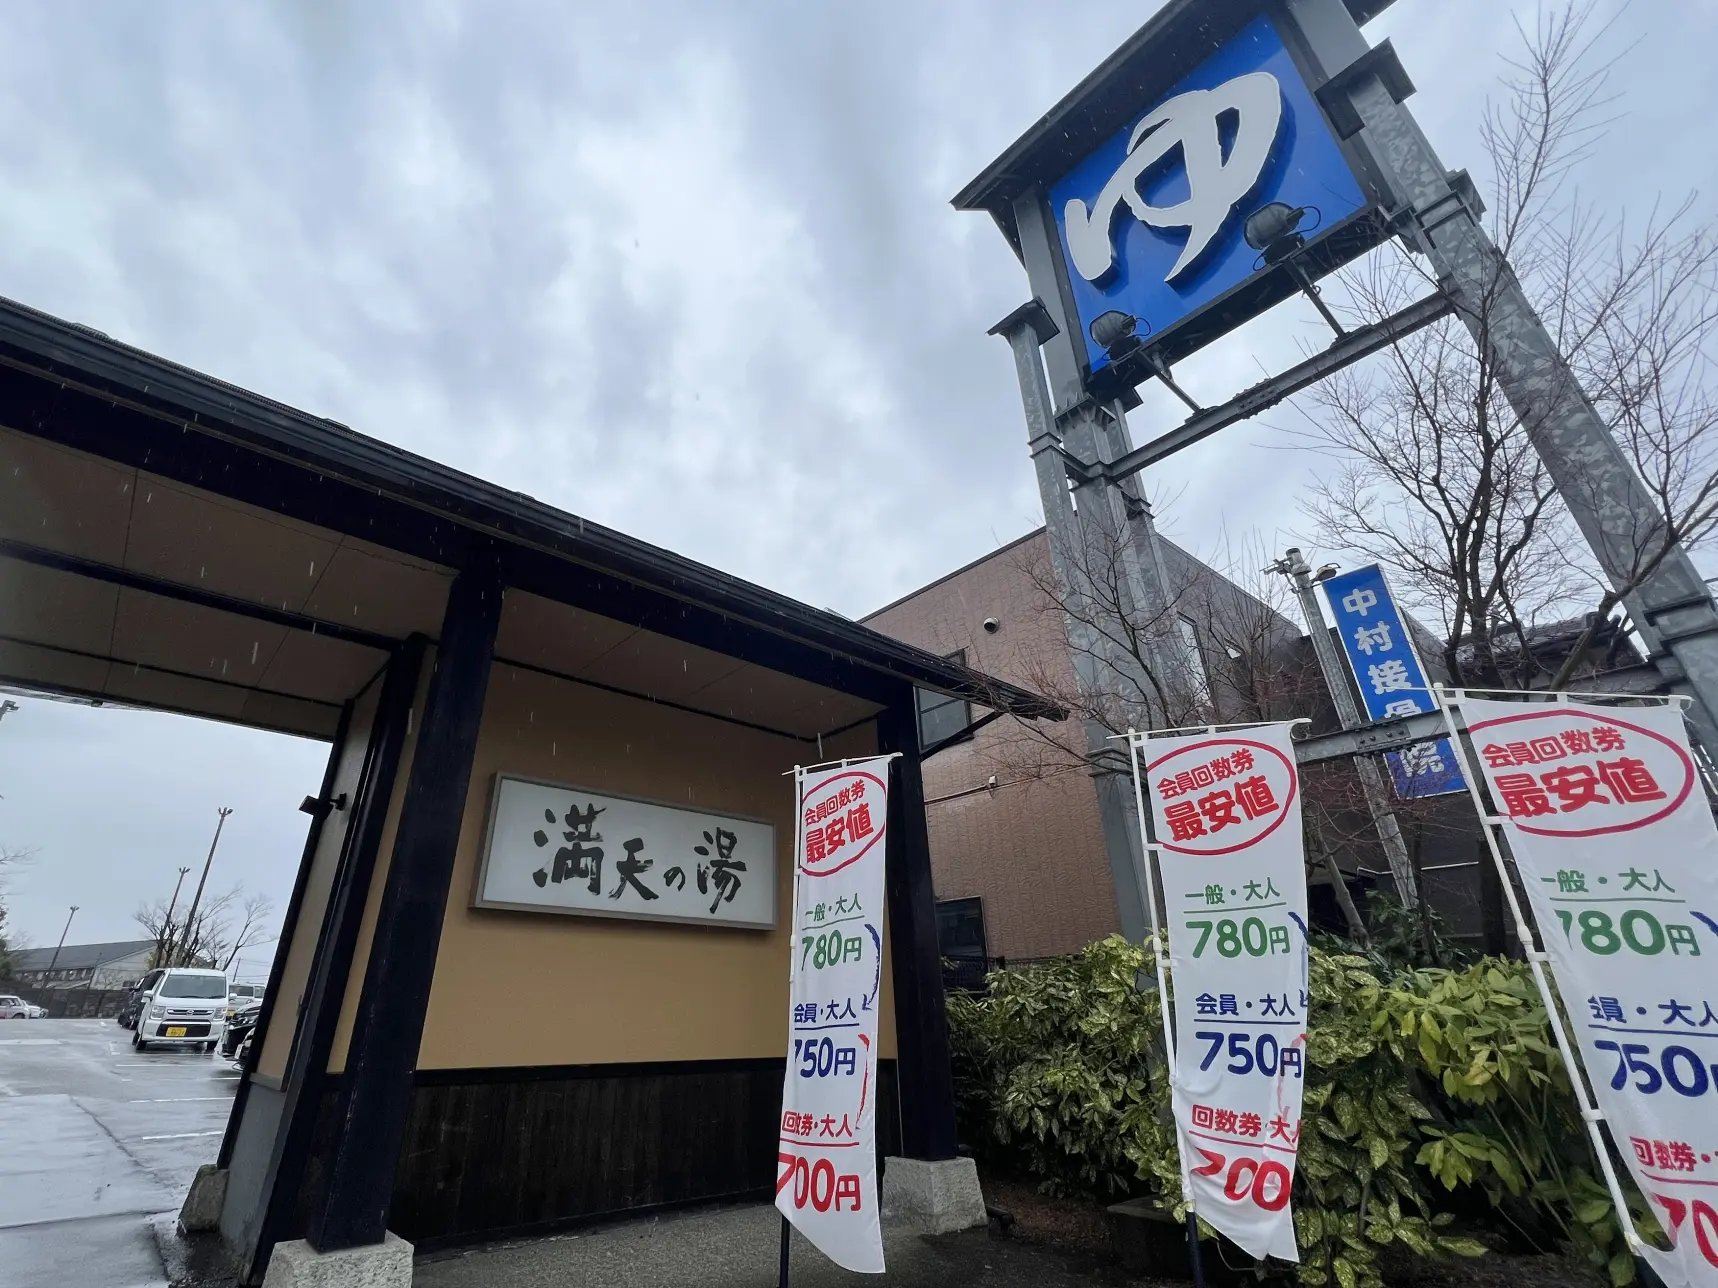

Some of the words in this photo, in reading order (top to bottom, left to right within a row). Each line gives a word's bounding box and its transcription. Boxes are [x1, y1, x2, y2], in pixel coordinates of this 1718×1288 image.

[1064, 71, 1282, 282] ゆ
[1482, 726, 1626, 769] 会員回数券
[1156, 748, 1255, 800] 会員回数券
[1494, 757, 1668, 818] 最安値
[804, 778, 866, 827] 会員回数券
[1164, 775, 1280, 842] 最安値
[533, 803, 747, 914] 満天の湯
[806, 802, 874, 864] 最安値
[804, 892, 863, 923] 一般・大人
[1185, 877, 1281, 905] 一般・大人
[1185, 916, 1291, 959] 780円
[1195, 992, 1296, 1017] 会員・大人
[1195, 1031, 1302, 1079] 750円
[1594, 1039, 1718, 1098] 750
[776, 1151, 862, 1212] 700円
